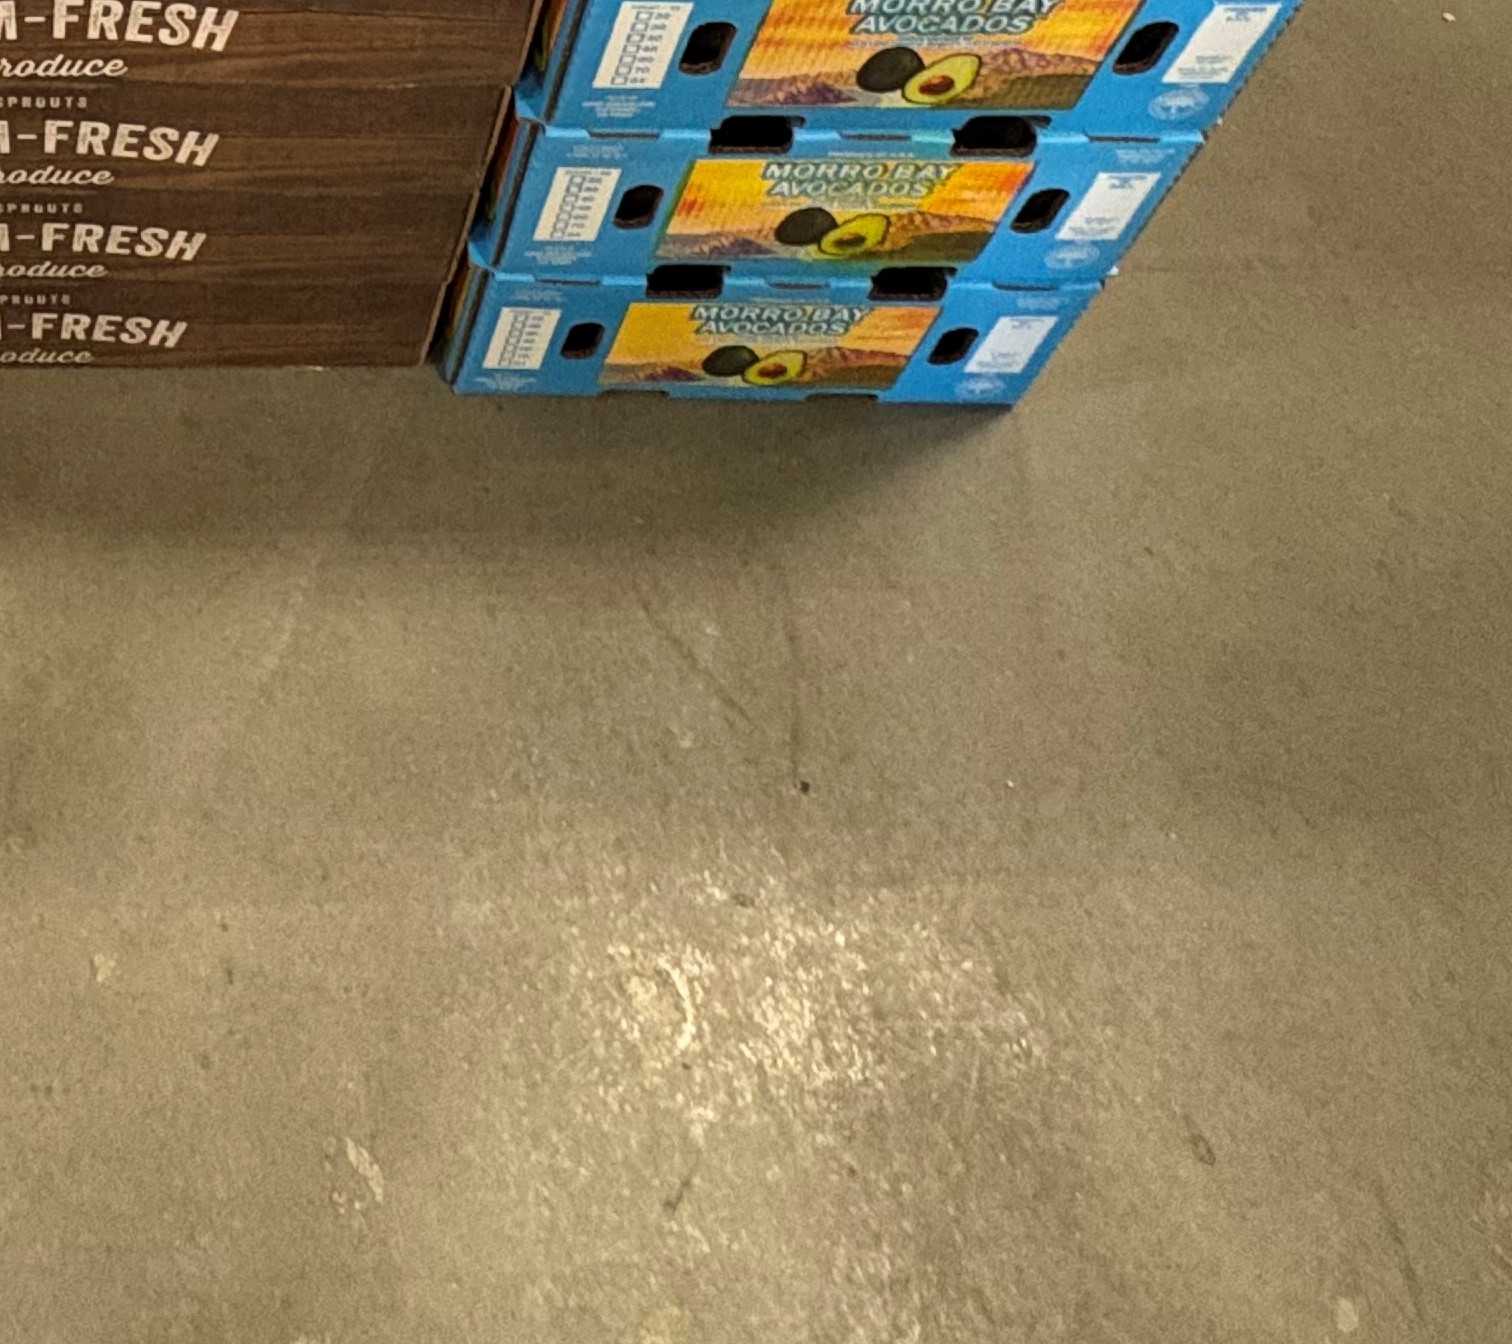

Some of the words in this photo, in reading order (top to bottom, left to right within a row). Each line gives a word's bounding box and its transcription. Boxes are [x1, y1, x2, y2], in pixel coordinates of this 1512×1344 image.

[853, 14, 1034, 34] AVOCADOS
[763, 162, 887, 182] MORRO
[894, 162, 962, 182] BAY
[767, 179, 930, 198] AVOCADOS
[692, 305, 803, 323] MORRO
[810, 305, 874, 323] BAY
[697, 320, 849, 336] AVOCADOS
